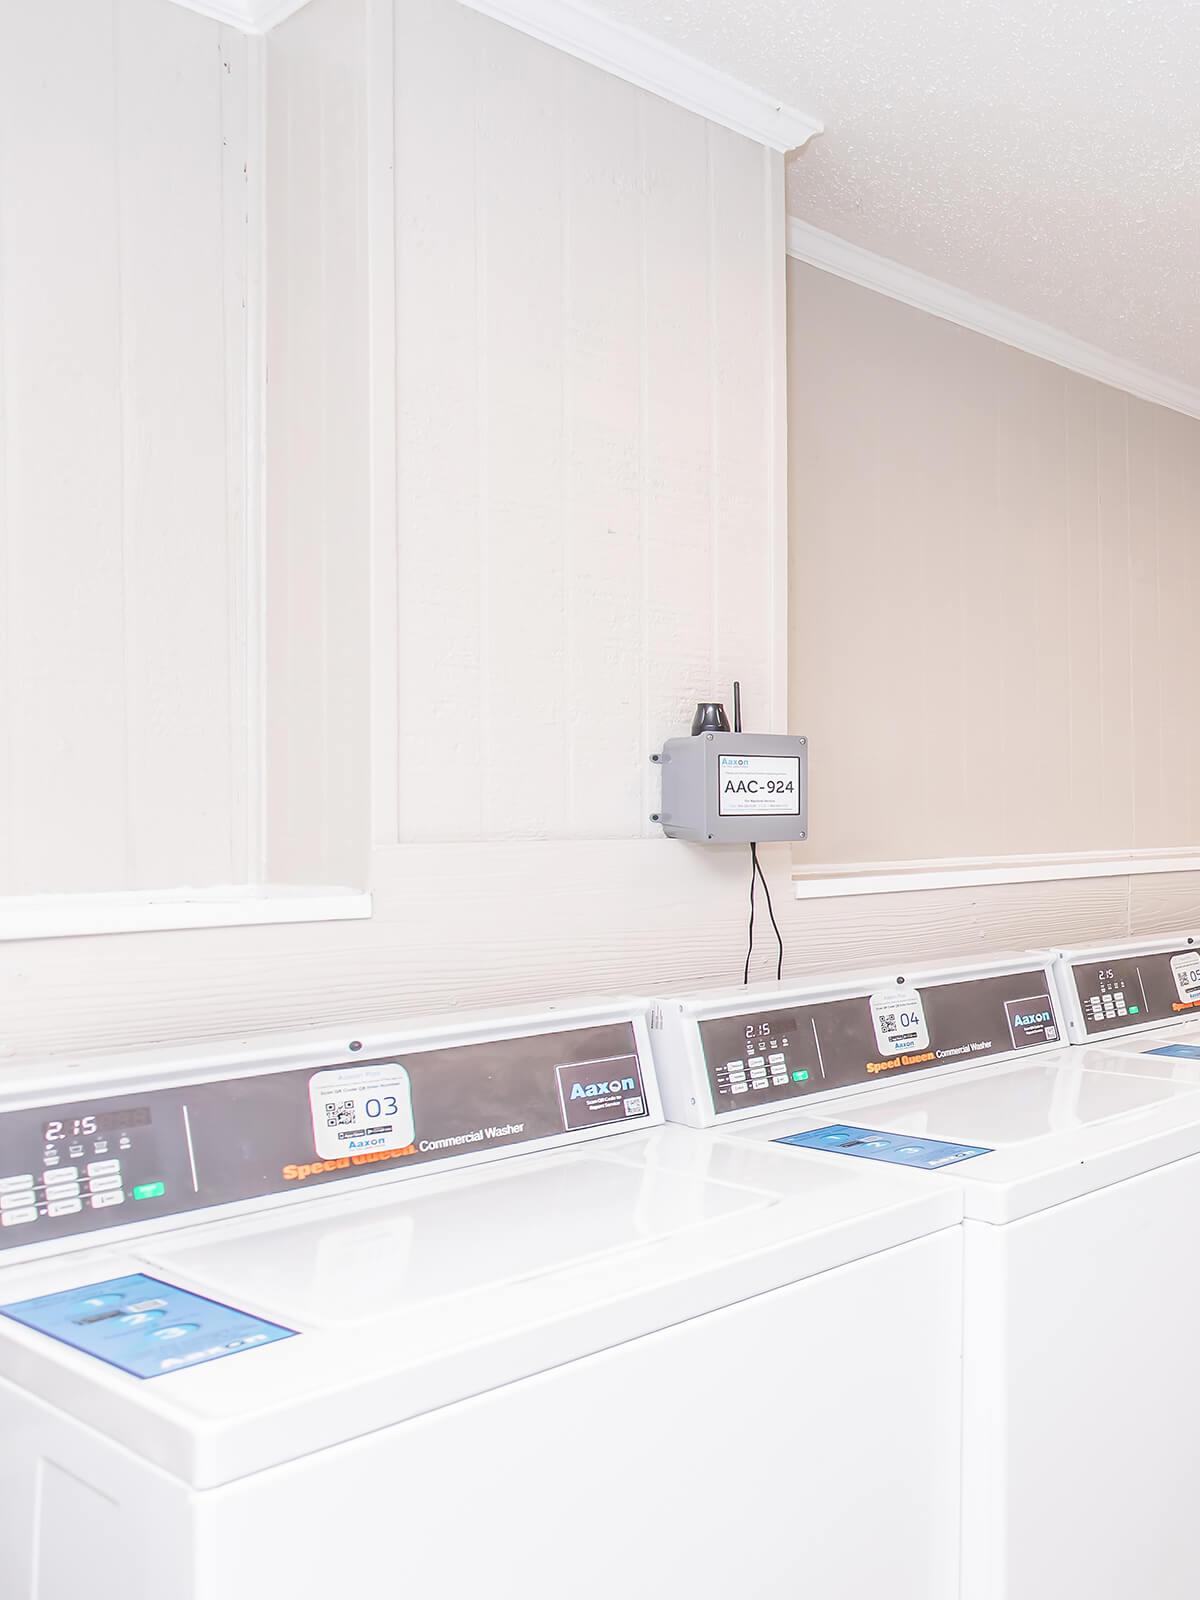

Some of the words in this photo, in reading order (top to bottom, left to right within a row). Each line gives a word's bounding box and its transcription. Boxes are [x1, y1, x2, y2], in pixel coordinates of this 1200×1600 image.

[724, 780, 794, 793] AAC-924
[900, 1011, 920, 1028] 04
[1015, 1011, 1050, 1027] Aaxon
[746, 1023, 770, 1038] 2.15
[866, 1057, 901, 1074] Speed
[901, 1051, 935, 1066] Queen
[935, 1044, 970, 1059] Commercial
[970, 1040, 992, 1051] Washer
[570, 1077, 635, 1100] Aaxon
[365, 1096, 399, 1118] 03
[45, 1116, 97, 1141] 2.15
[282, 1157, 350, 1180] Speed
[419, 1131, 485, 1152] Commercial
[485, 1122, 524, 1139] Washer
[348, 1137, 385, 1149] Aaxon
